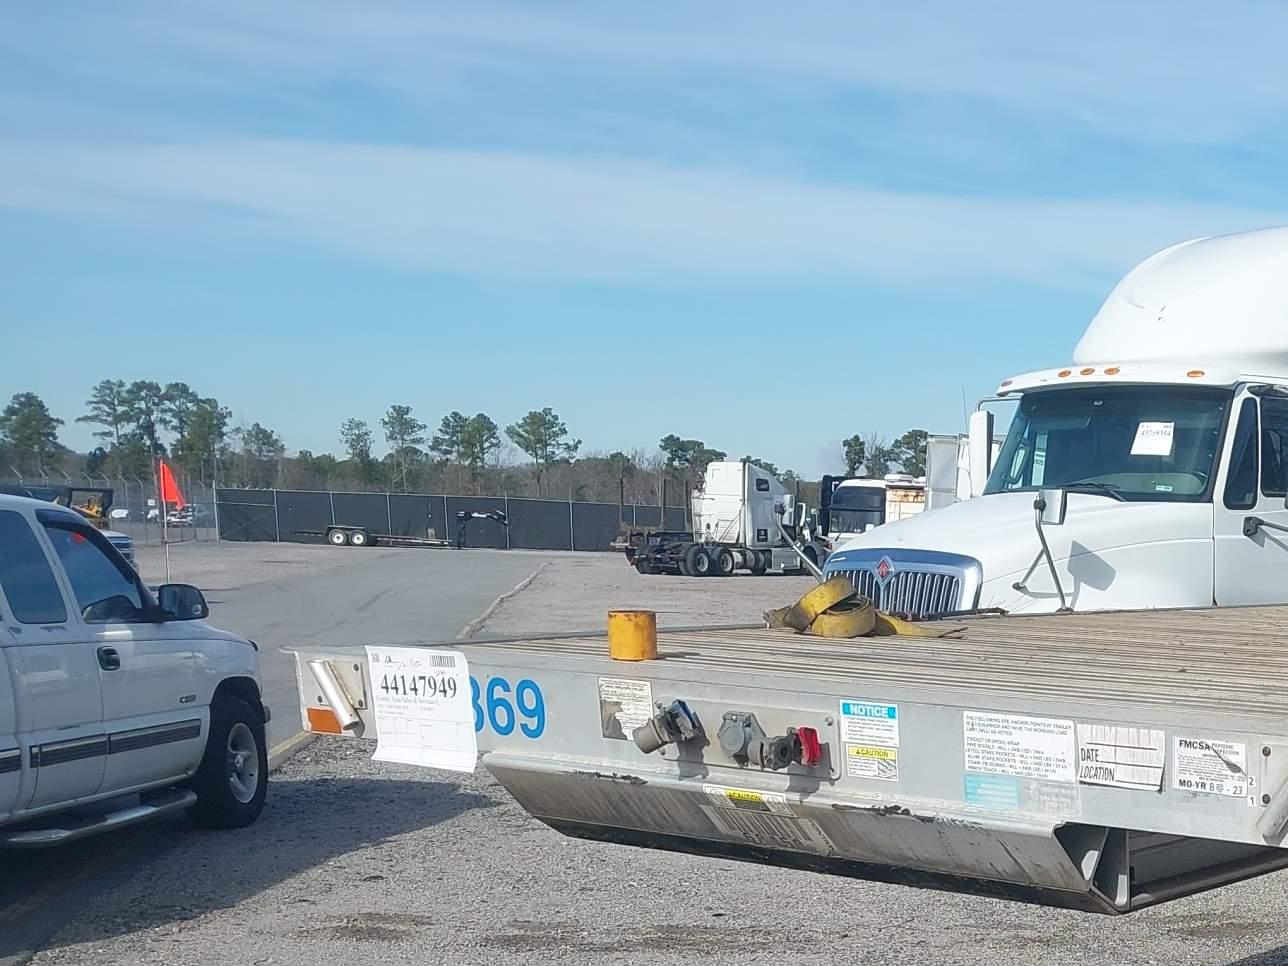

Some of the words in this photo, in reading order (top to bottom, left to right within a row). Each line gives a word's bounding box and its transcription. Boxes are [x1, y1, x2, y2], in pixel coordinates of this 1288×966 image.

[380, 673, 457, 698] 44147949
[849, 704, 888, 717] NOTICE
[1180, 740, 1210, 752] FMCSA
[860, 748, 888, 758] CAUTION
[1080, 748, 1099, 762] DATE
[1080, 766, 1115, 782] LOCATION
[1178, 779, 1206, 790] MO-YR
[1232, 786, 1243, 794] 23
[1248, 776, 1254, 786] 2
[732, 792, 761, 800] CAUTION
